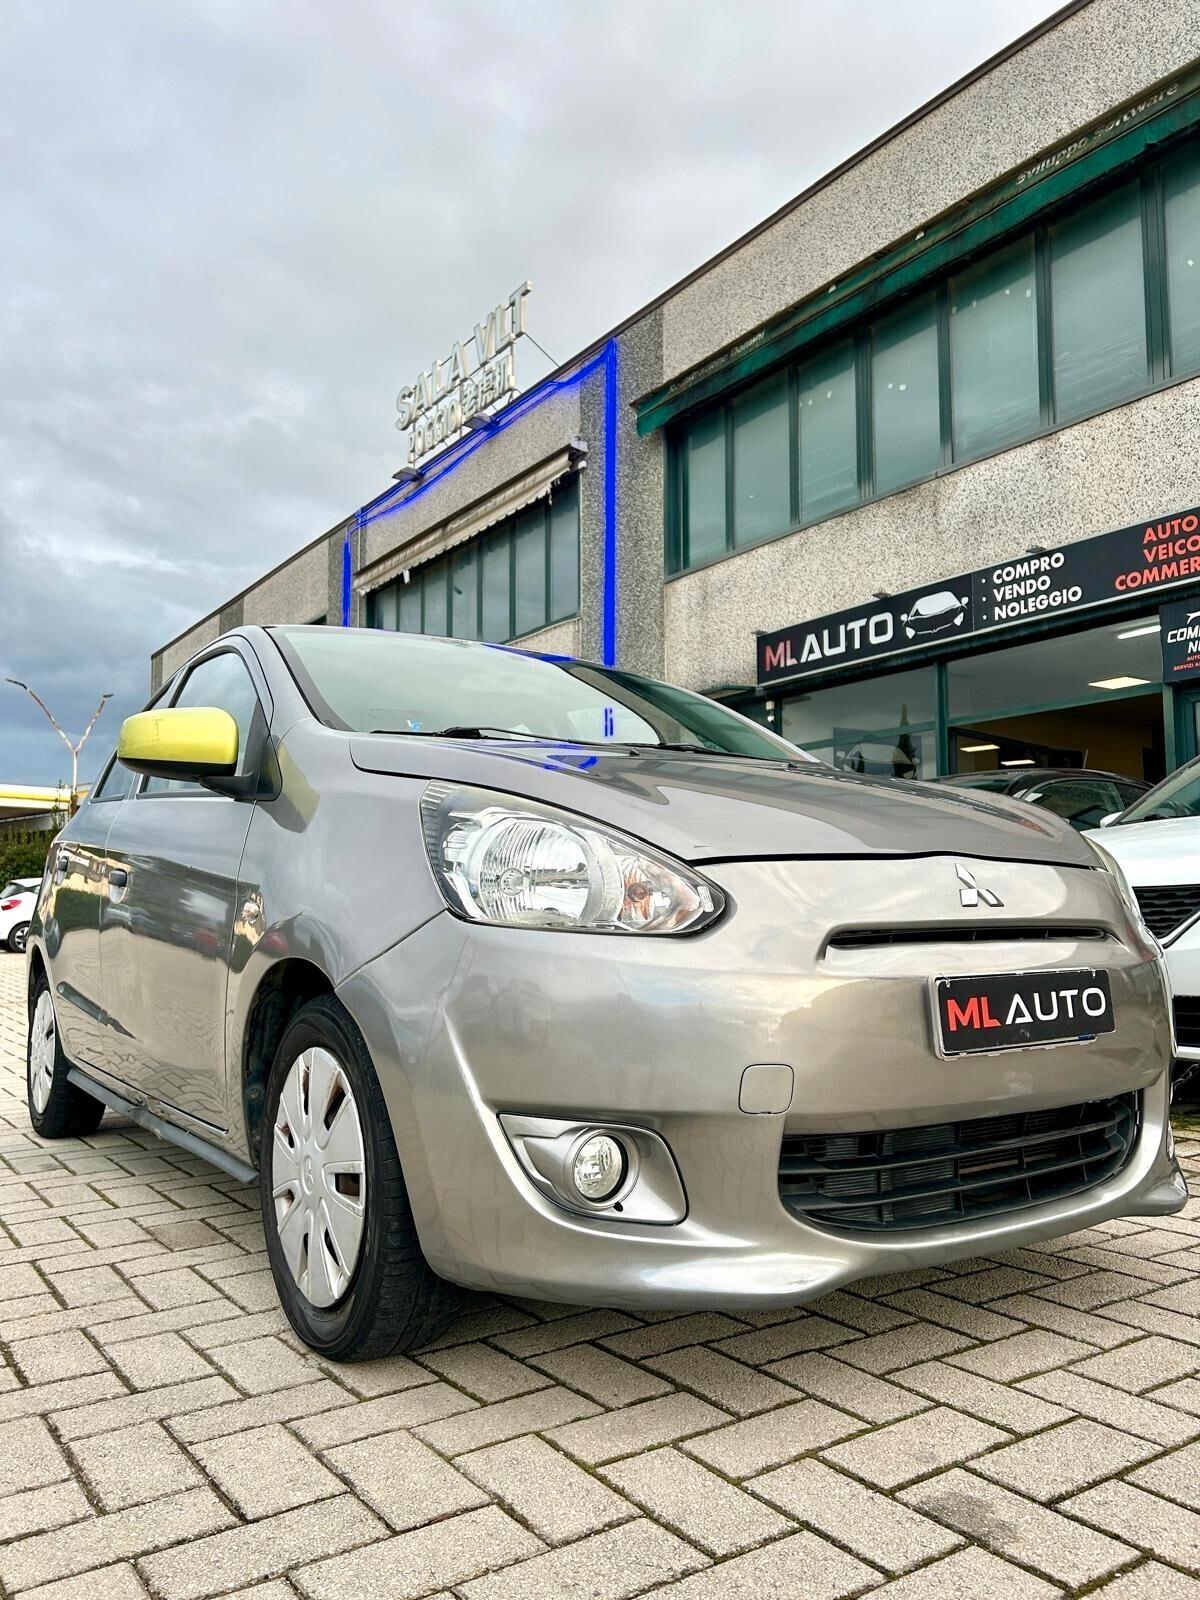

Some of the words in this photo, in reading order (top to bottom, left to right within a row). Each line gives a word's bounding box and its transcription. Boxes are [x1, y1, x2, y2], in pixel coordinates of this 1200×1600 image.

[395, 340, 467, 431] SALA
[473, 280, 533, 367] VLT
[1143, 515, 1199, 544] AUTO
[1143, 535, 1200, 563] VEICO
[993, 552, 1064, 584] COMPRO
[1115, 556, 1200, 590] COMMER
[993, 575, 1051, 602] VENDO
[994, 586, 1082, 621] NOLEGGIO
[765, 640, 798, 671] ML
[800, 612, 894, 663] AUTO
[946, 996, 1002, 1031] ML
[1005, 987, 1106, 1025] AUTO
